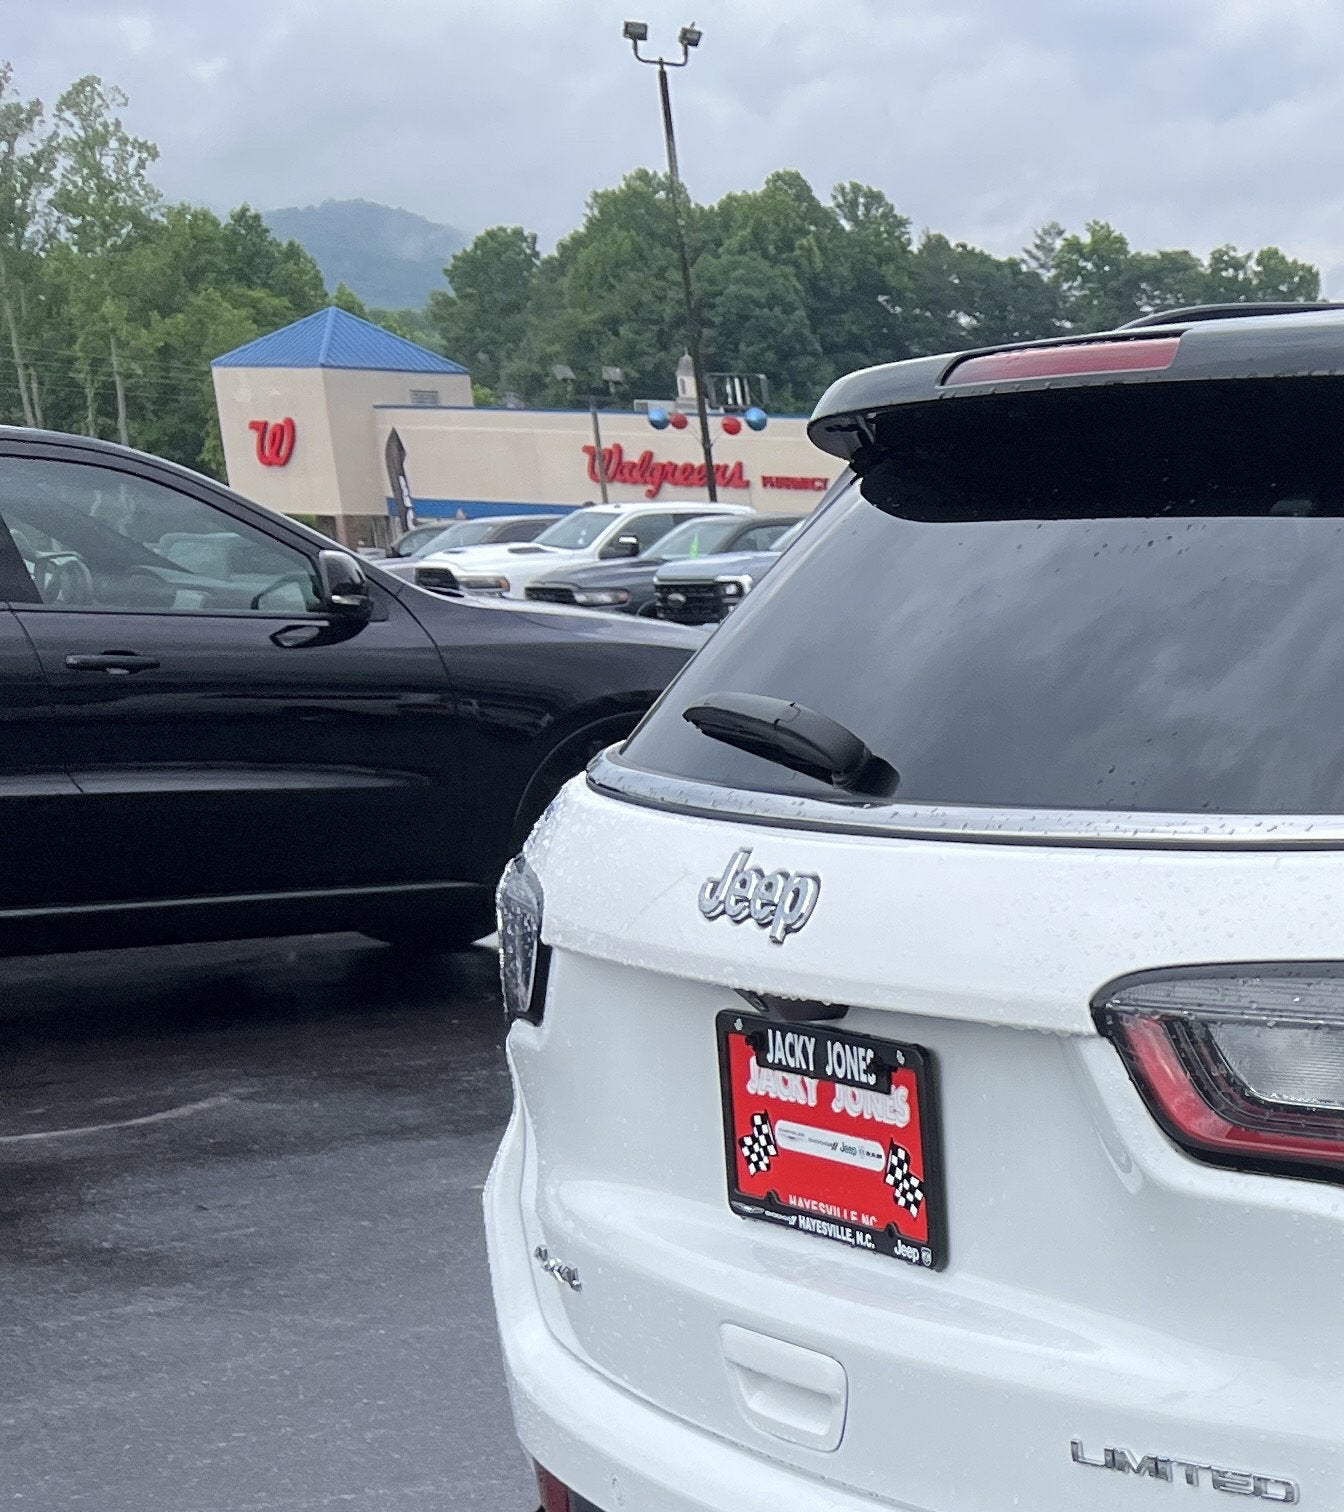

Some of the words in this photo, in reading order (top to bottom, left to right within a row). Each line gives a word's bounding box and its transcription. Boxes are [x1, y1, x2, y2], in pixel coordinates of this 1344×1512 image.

[248, 416, 297, 467] W
[582, 443, 752, 498] Walgreens
[698, 847, 821, 945] Jeep
[766, 1028, 816, 1072] JACKY
[746, 1055, 820, 1107] JACKY
[831, 1082, 911, 1128] JONES
[893, 1239, 921, 1263] Jeep
[1070, 1437, 1300, 1505] LIMITED
